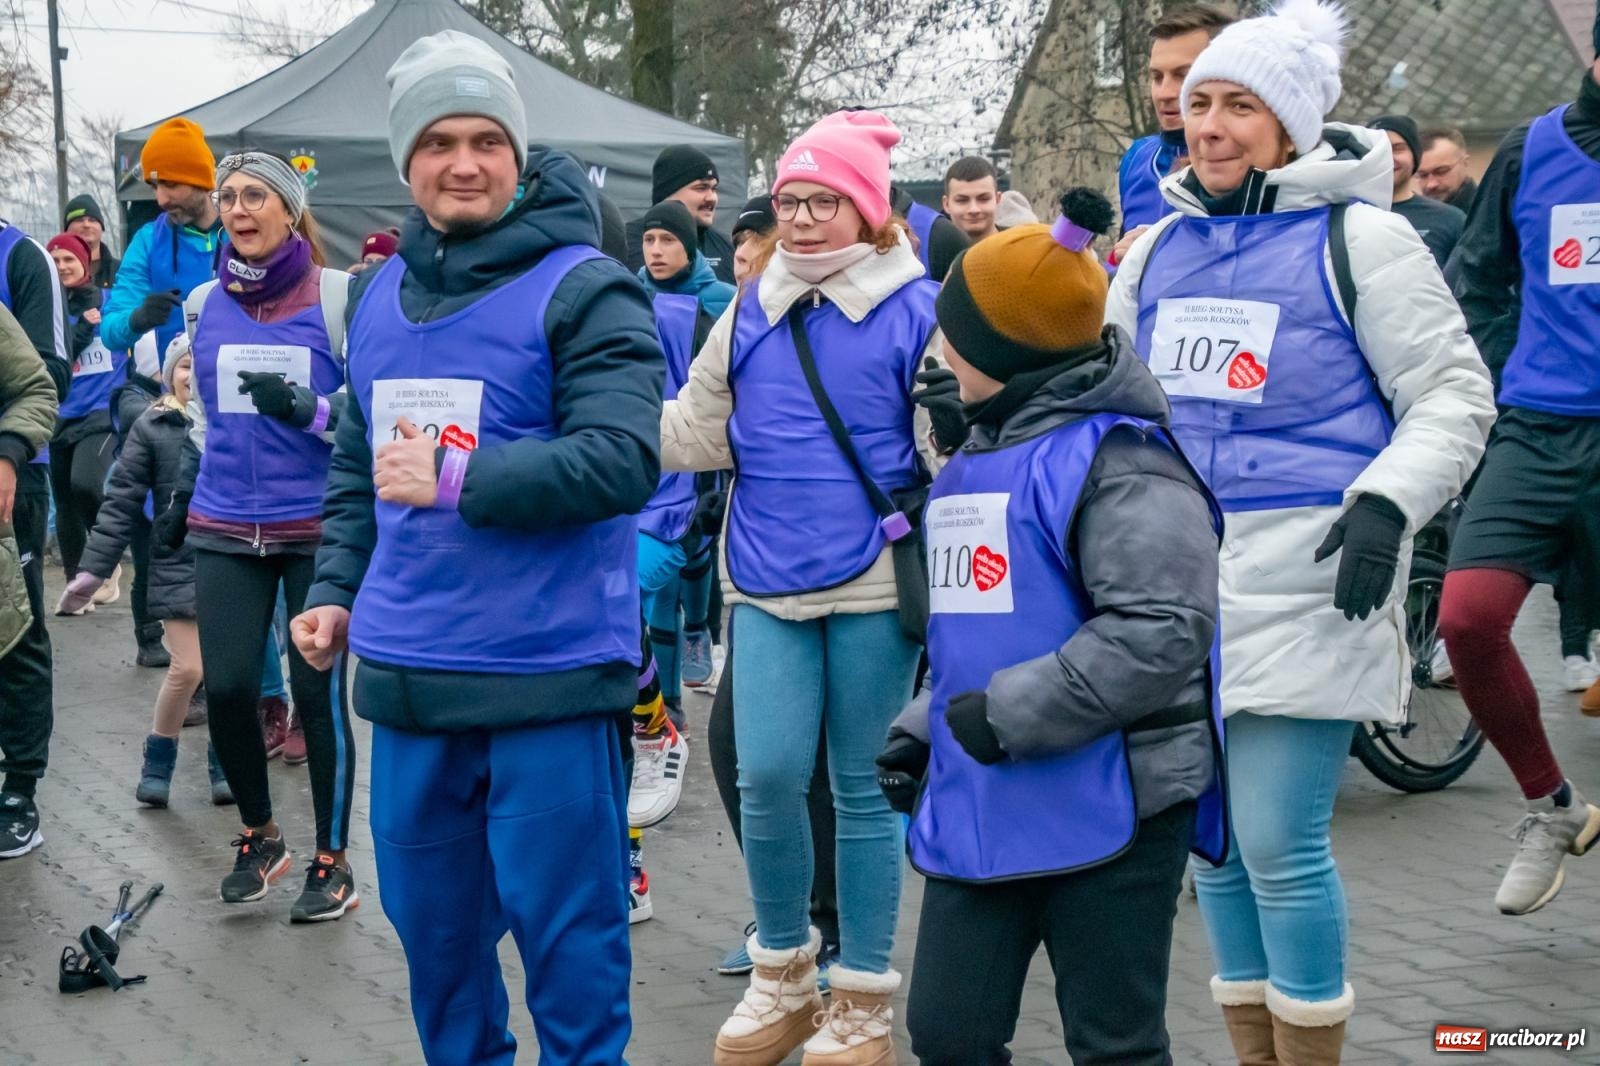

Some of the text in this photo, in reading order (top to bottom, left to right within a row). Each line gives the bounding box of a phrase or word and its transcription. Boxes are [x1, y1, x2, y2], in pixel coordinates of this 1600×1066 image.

[1190, 305, 1207, 313] BIEG
[1209, 306, 1244, 315] SOŁTYSA
[1210, 316, 1251, 326] ROSZKÓW
[1170, 336, 1240, 374] 107
[418, 390, 448, 398] SOŁTYSA
[420, 400, 456, 408] ROSZKÓW
[931, 545, 972, 588] 110
